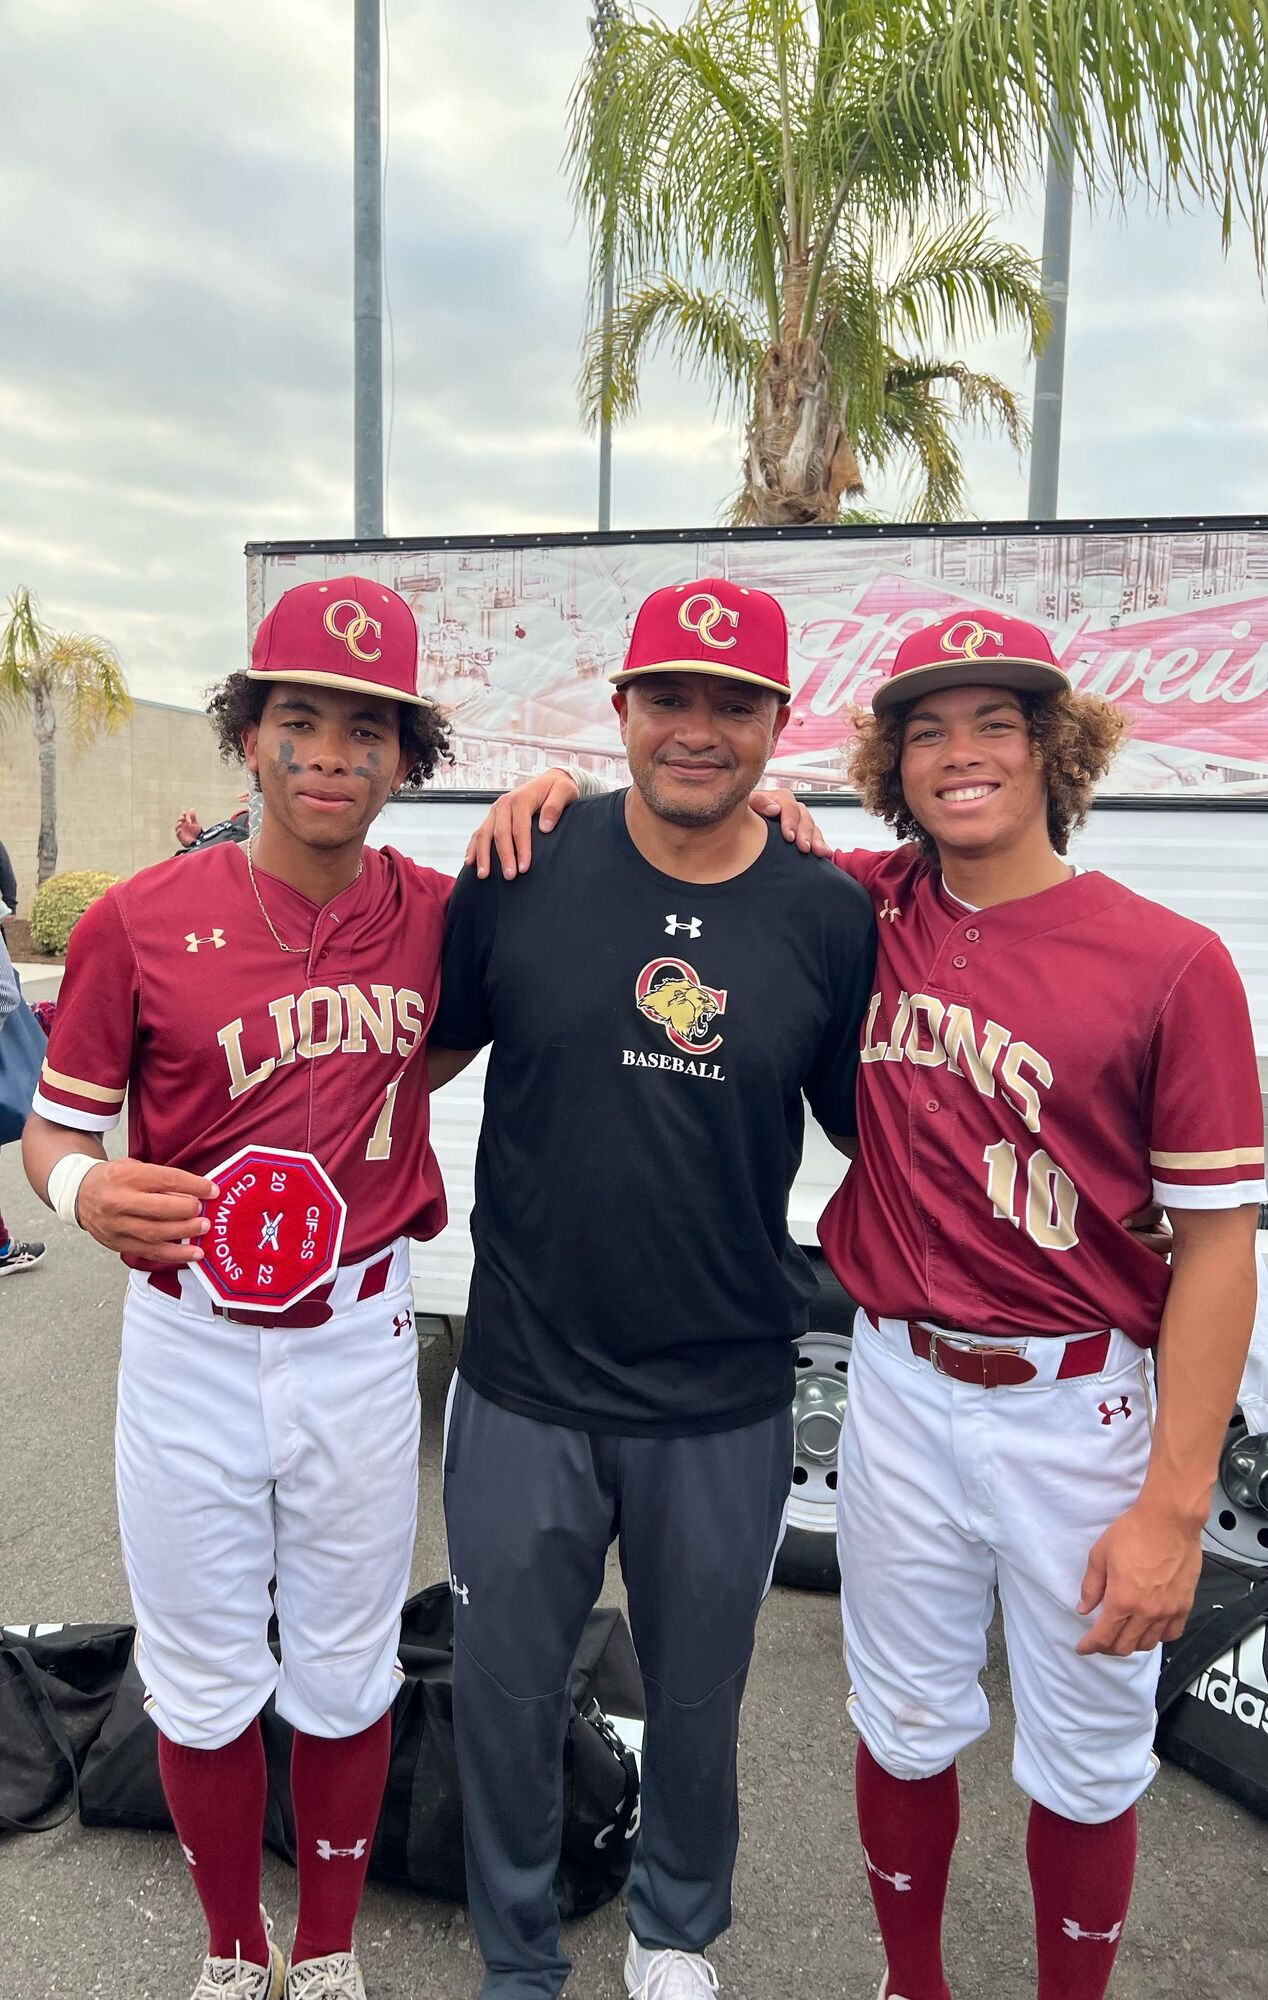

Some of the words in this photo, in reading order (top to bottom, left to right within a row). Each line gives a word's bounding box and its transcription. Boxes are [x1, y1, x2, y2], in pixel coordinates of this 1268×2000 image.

[323, 600, 381, 662] OC
[678, 593, 739, 649] OC
[217, 984, 425, 1100] LIONS
[622, 1050, 725, 1081] BASEBALL
[860, 991, 1053, 1133] LIONS
[365, 1072, 404, 1160] 1
[270, 1172, 287, 1192] 20
[983, 1138, 1079, 1251] 10
[214, 1173, 256, 1281] CHAMPIONS
[301, 1206, 320, 1260] CIF-SS
[257, 1264, 274, 1286] 22
